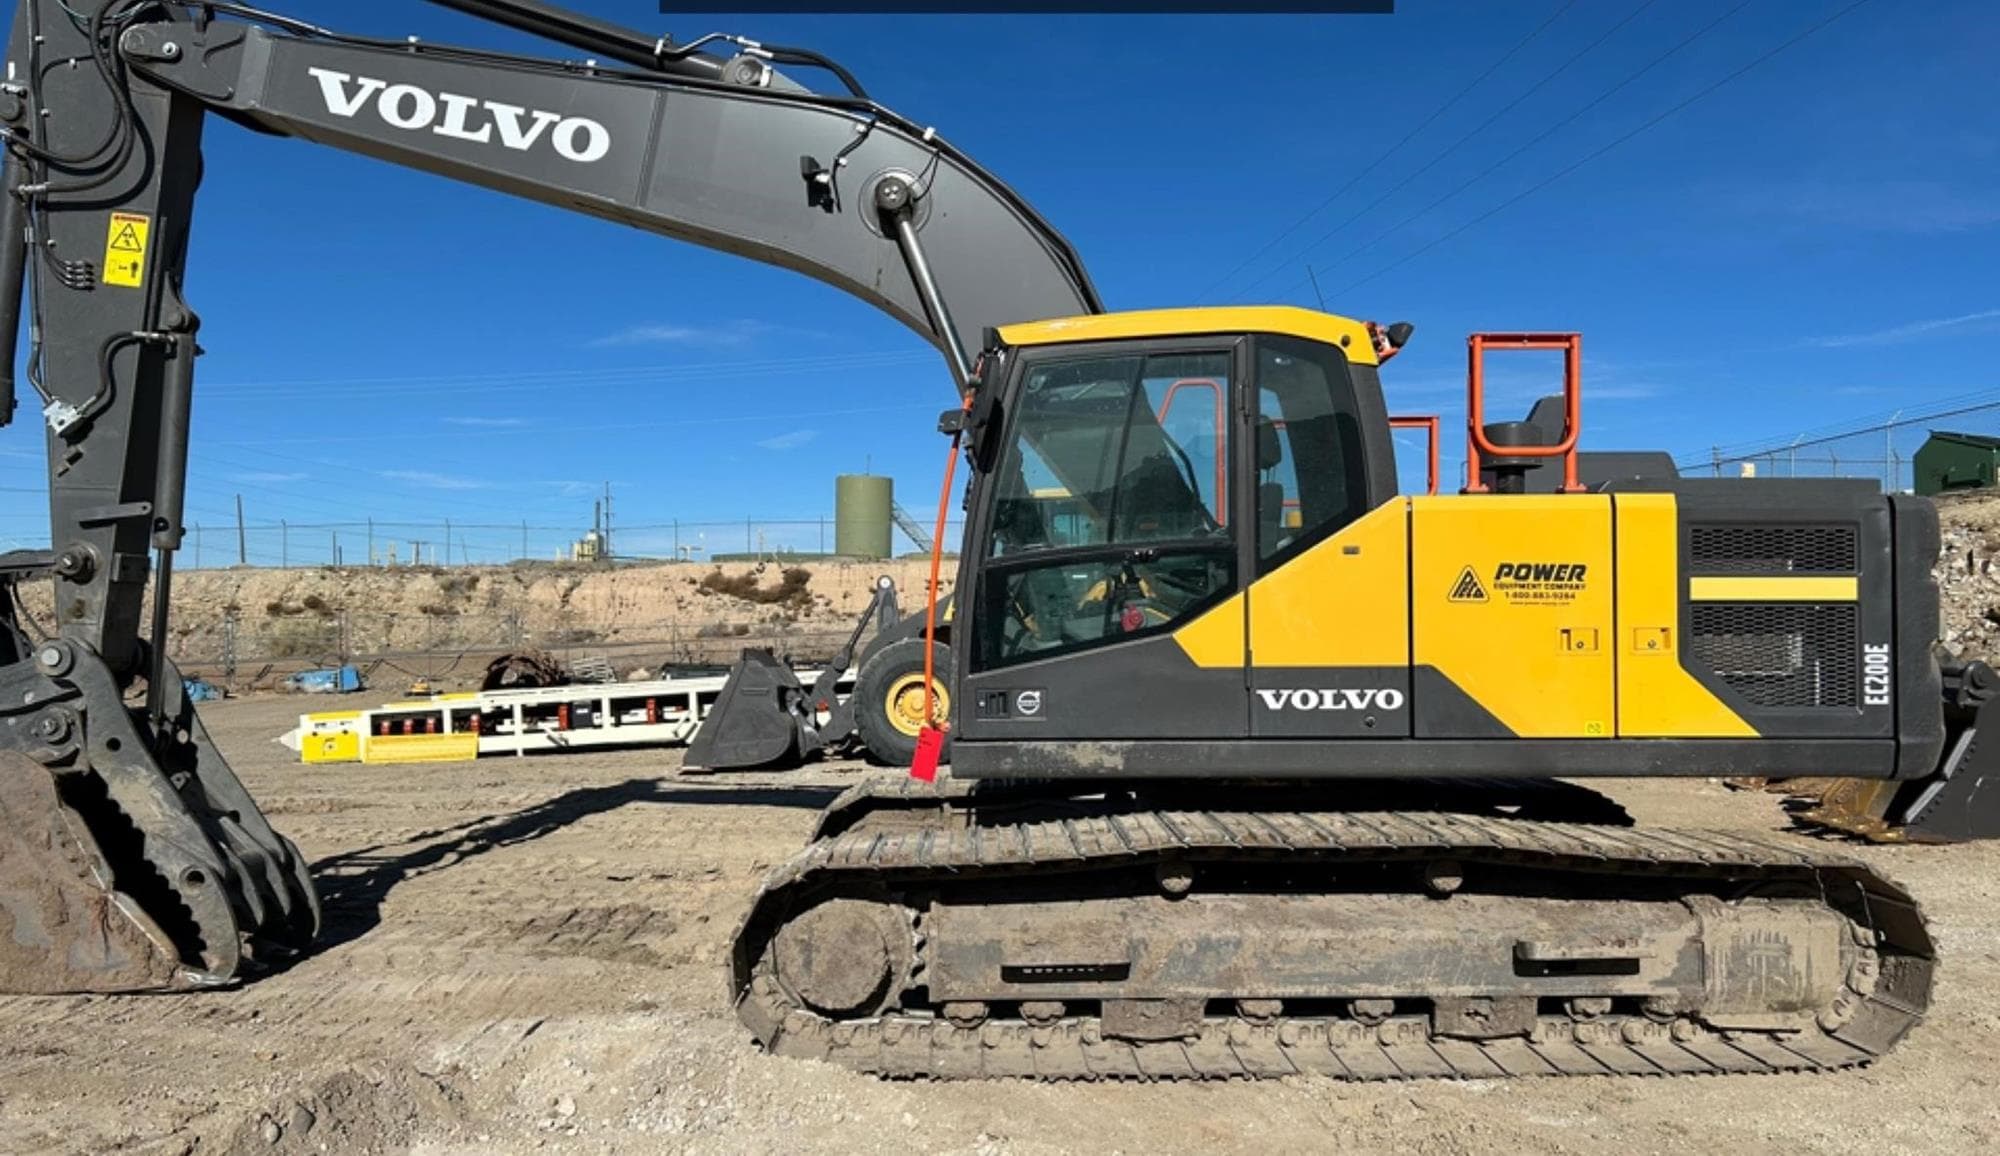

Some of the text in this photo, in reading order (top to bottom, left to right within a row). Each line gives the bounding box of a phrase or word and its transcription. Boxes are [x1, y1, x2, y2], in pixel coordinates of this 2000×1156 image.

[308, 67, 611, 162] VOLVO
[1495, 563, 1587, 581] POWER
[1544, 583, 1586, 591] COMPANY
[1864, 643, 1889, 705] EC200E
[1256, 689, 1404, 711] VOLVO
